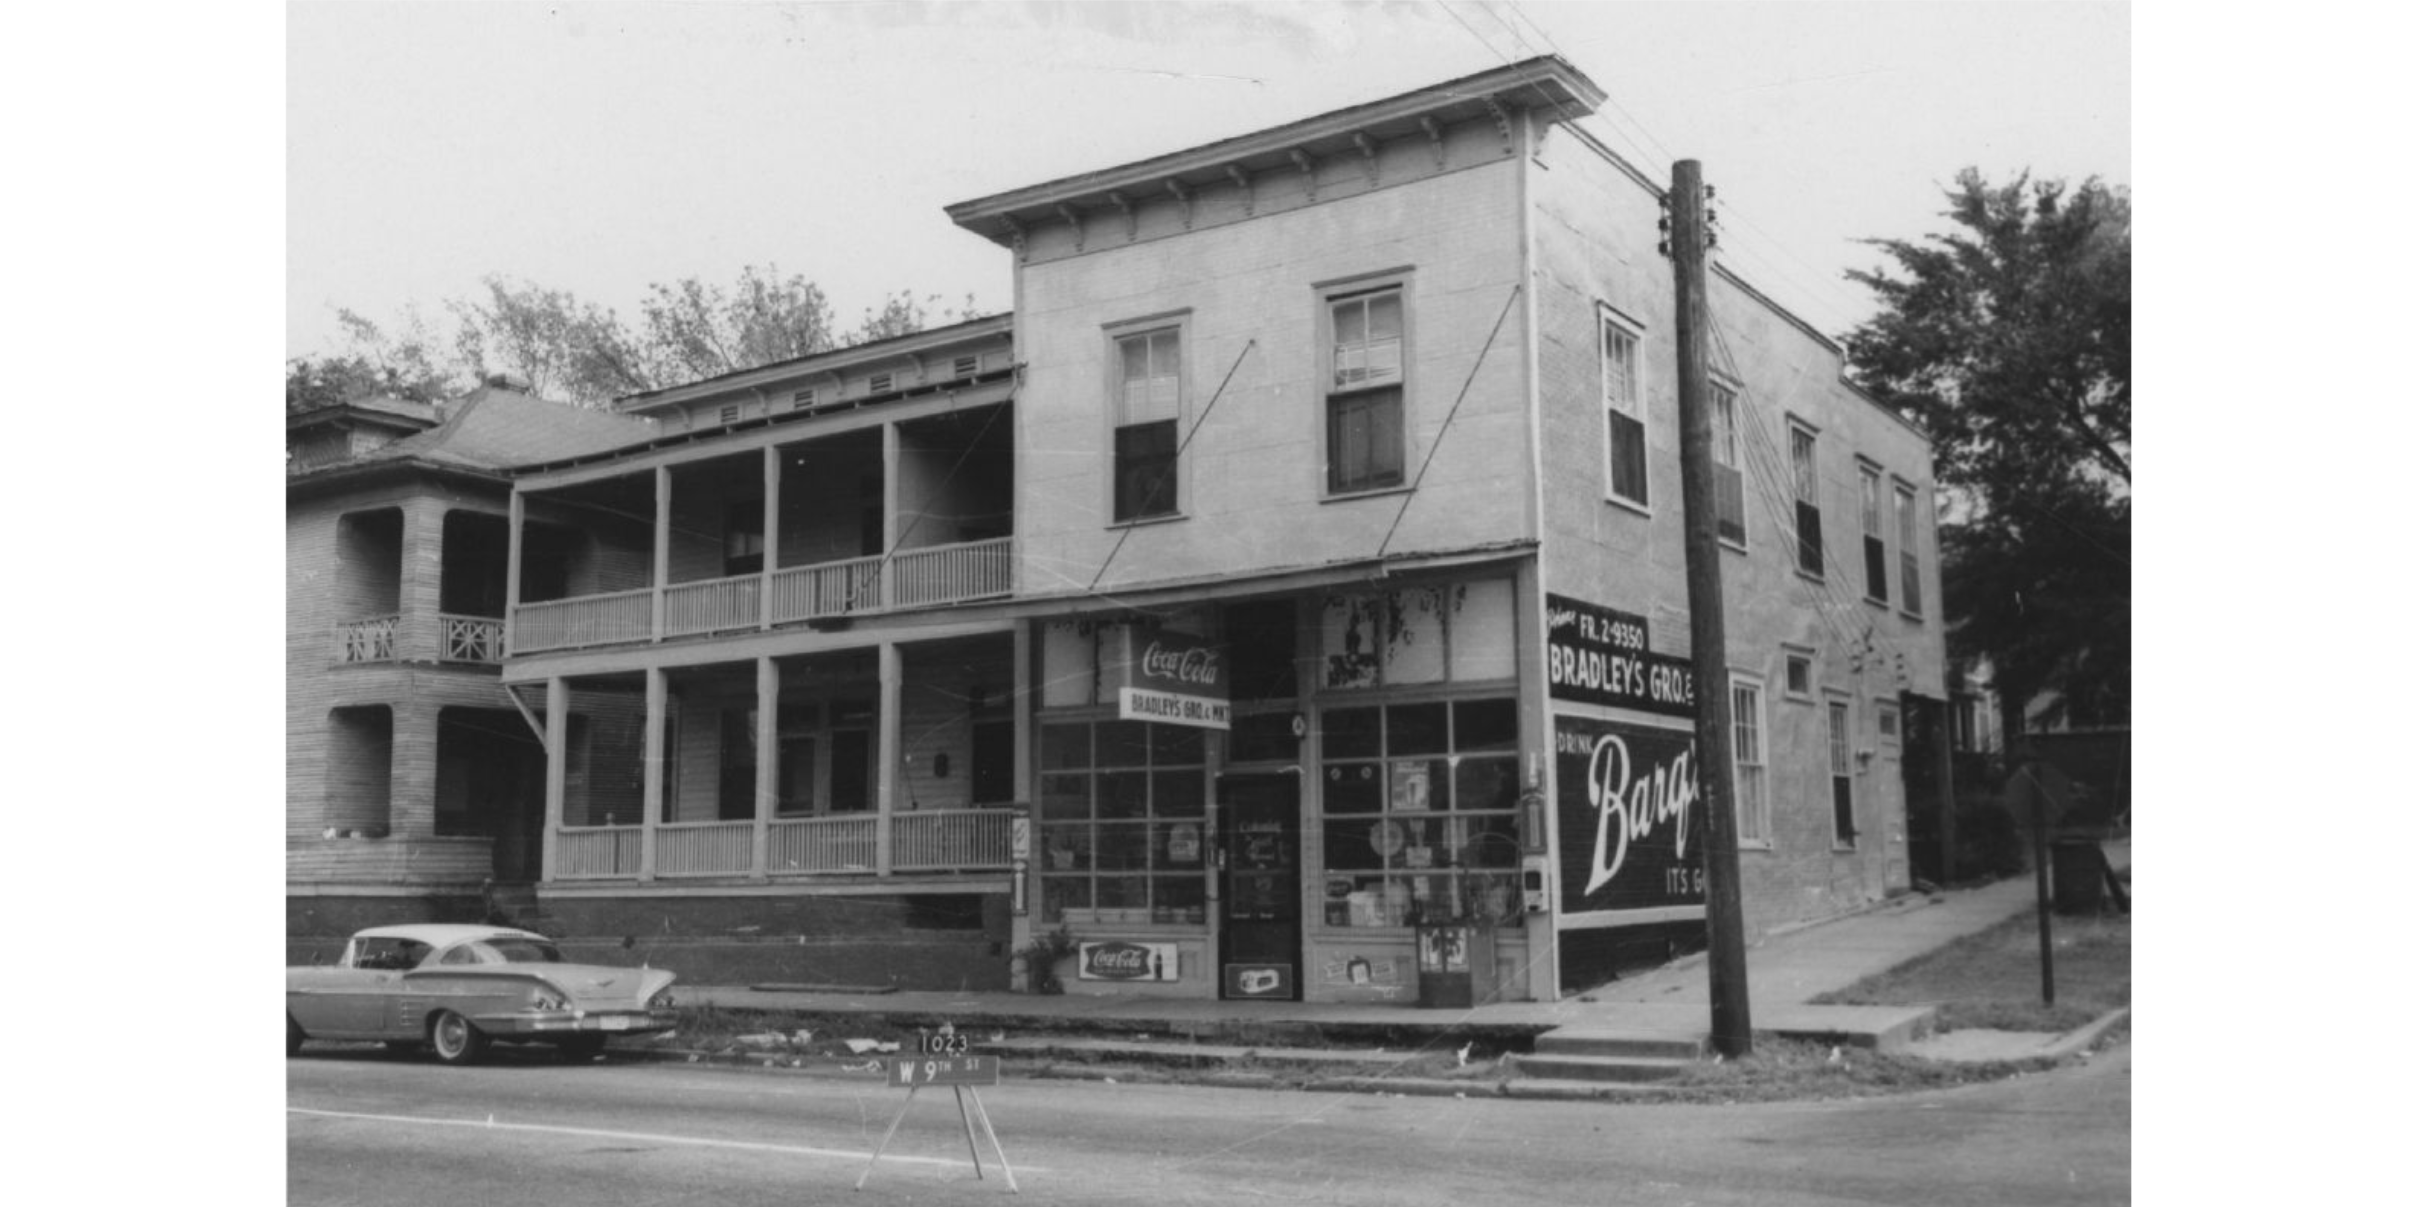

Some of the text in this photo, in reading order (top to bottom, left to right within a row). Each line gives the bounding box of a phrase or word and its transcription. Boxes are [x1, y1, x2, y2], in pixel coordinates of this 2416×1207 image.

[1580, 614, 1600, 641] FR.
[1602, 619, 1644, 650] 2-9350
[1550, 643, 1645, 697] BRADLEY'S
[1651, 664, 1686, 704] GRO.
[1132, 694, 1180, 718] BRADLEY'S
[1556, 731, 1594, 755] DRINK
[921, 1034, 967, 1052] 1023
[900, 1058, 979, 1083] W 9TH ST
